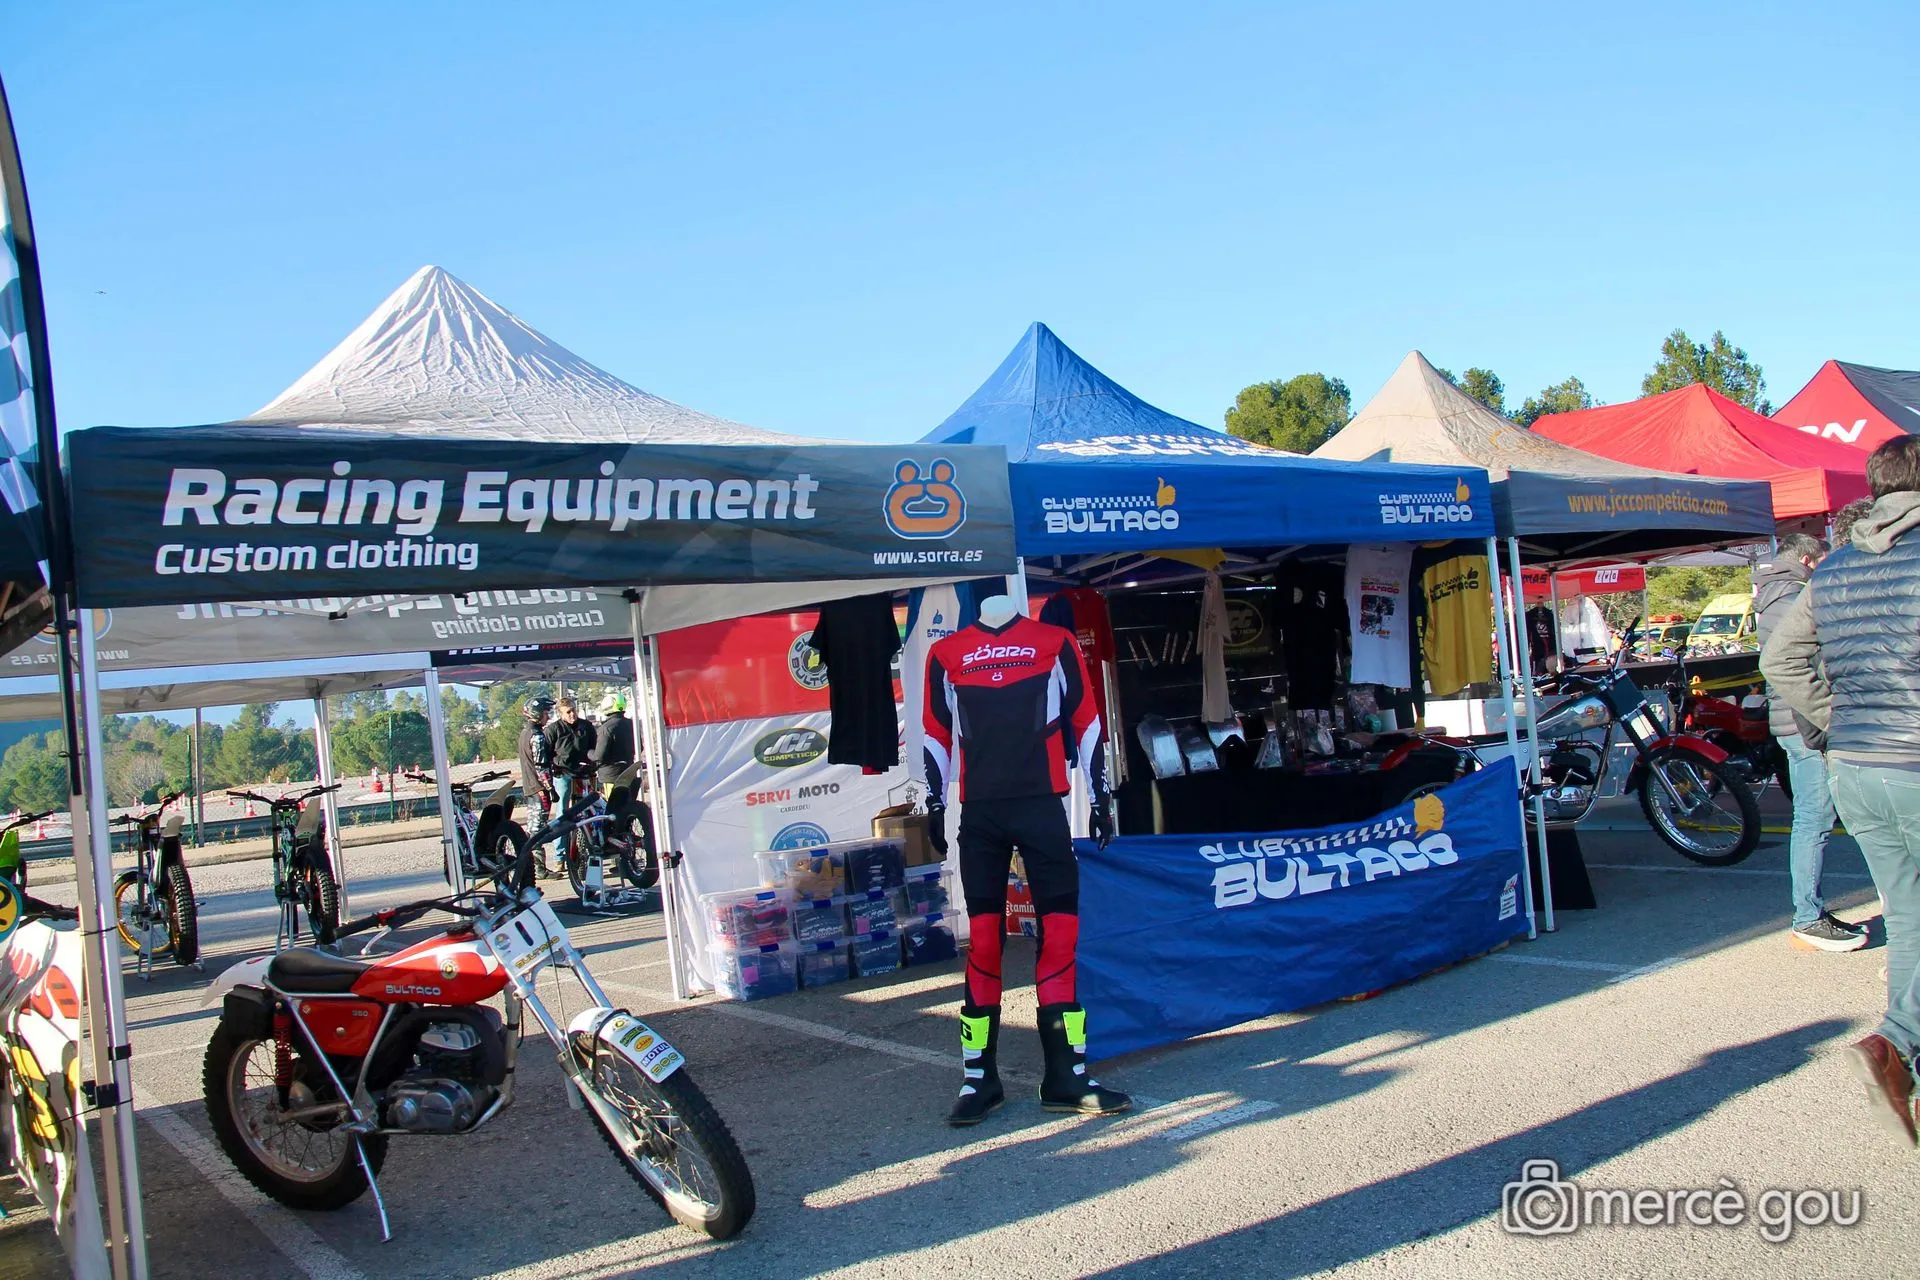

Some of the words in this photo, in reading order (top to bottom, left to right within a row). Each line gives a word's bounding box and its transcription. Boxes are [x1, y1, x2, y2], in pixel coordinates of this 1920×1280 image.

[163, 461, 444, 535] Racing
[458, 461, 819, 532] Equipment
[1042, 497, 1087, 510] CLUB
[1379, 494, 1410, 504] CLUB
[1567, 487, 1728, 517] www.jcccompeticio.com
[1044, 509, 1179, 533] BULTACO
[1381, 504, 1473, 524] BULTACO
[155, 544, 316, 575] Custom
[326, 537, 479, 571] clothing
[873, 549, 983, 565] www.sorra.es
[763, 732, 818, 755] JCC
[745, 789, 791, 806] SERVI
[798, 783, 840, 799] MOTO
[1200, 837, 1287, 863] CLUB
[1211, 832, 1459, 909] BULTACO
[385, 984, 441, 996] BULTACO
[641, 1041, 671, 1067] MOTUL
